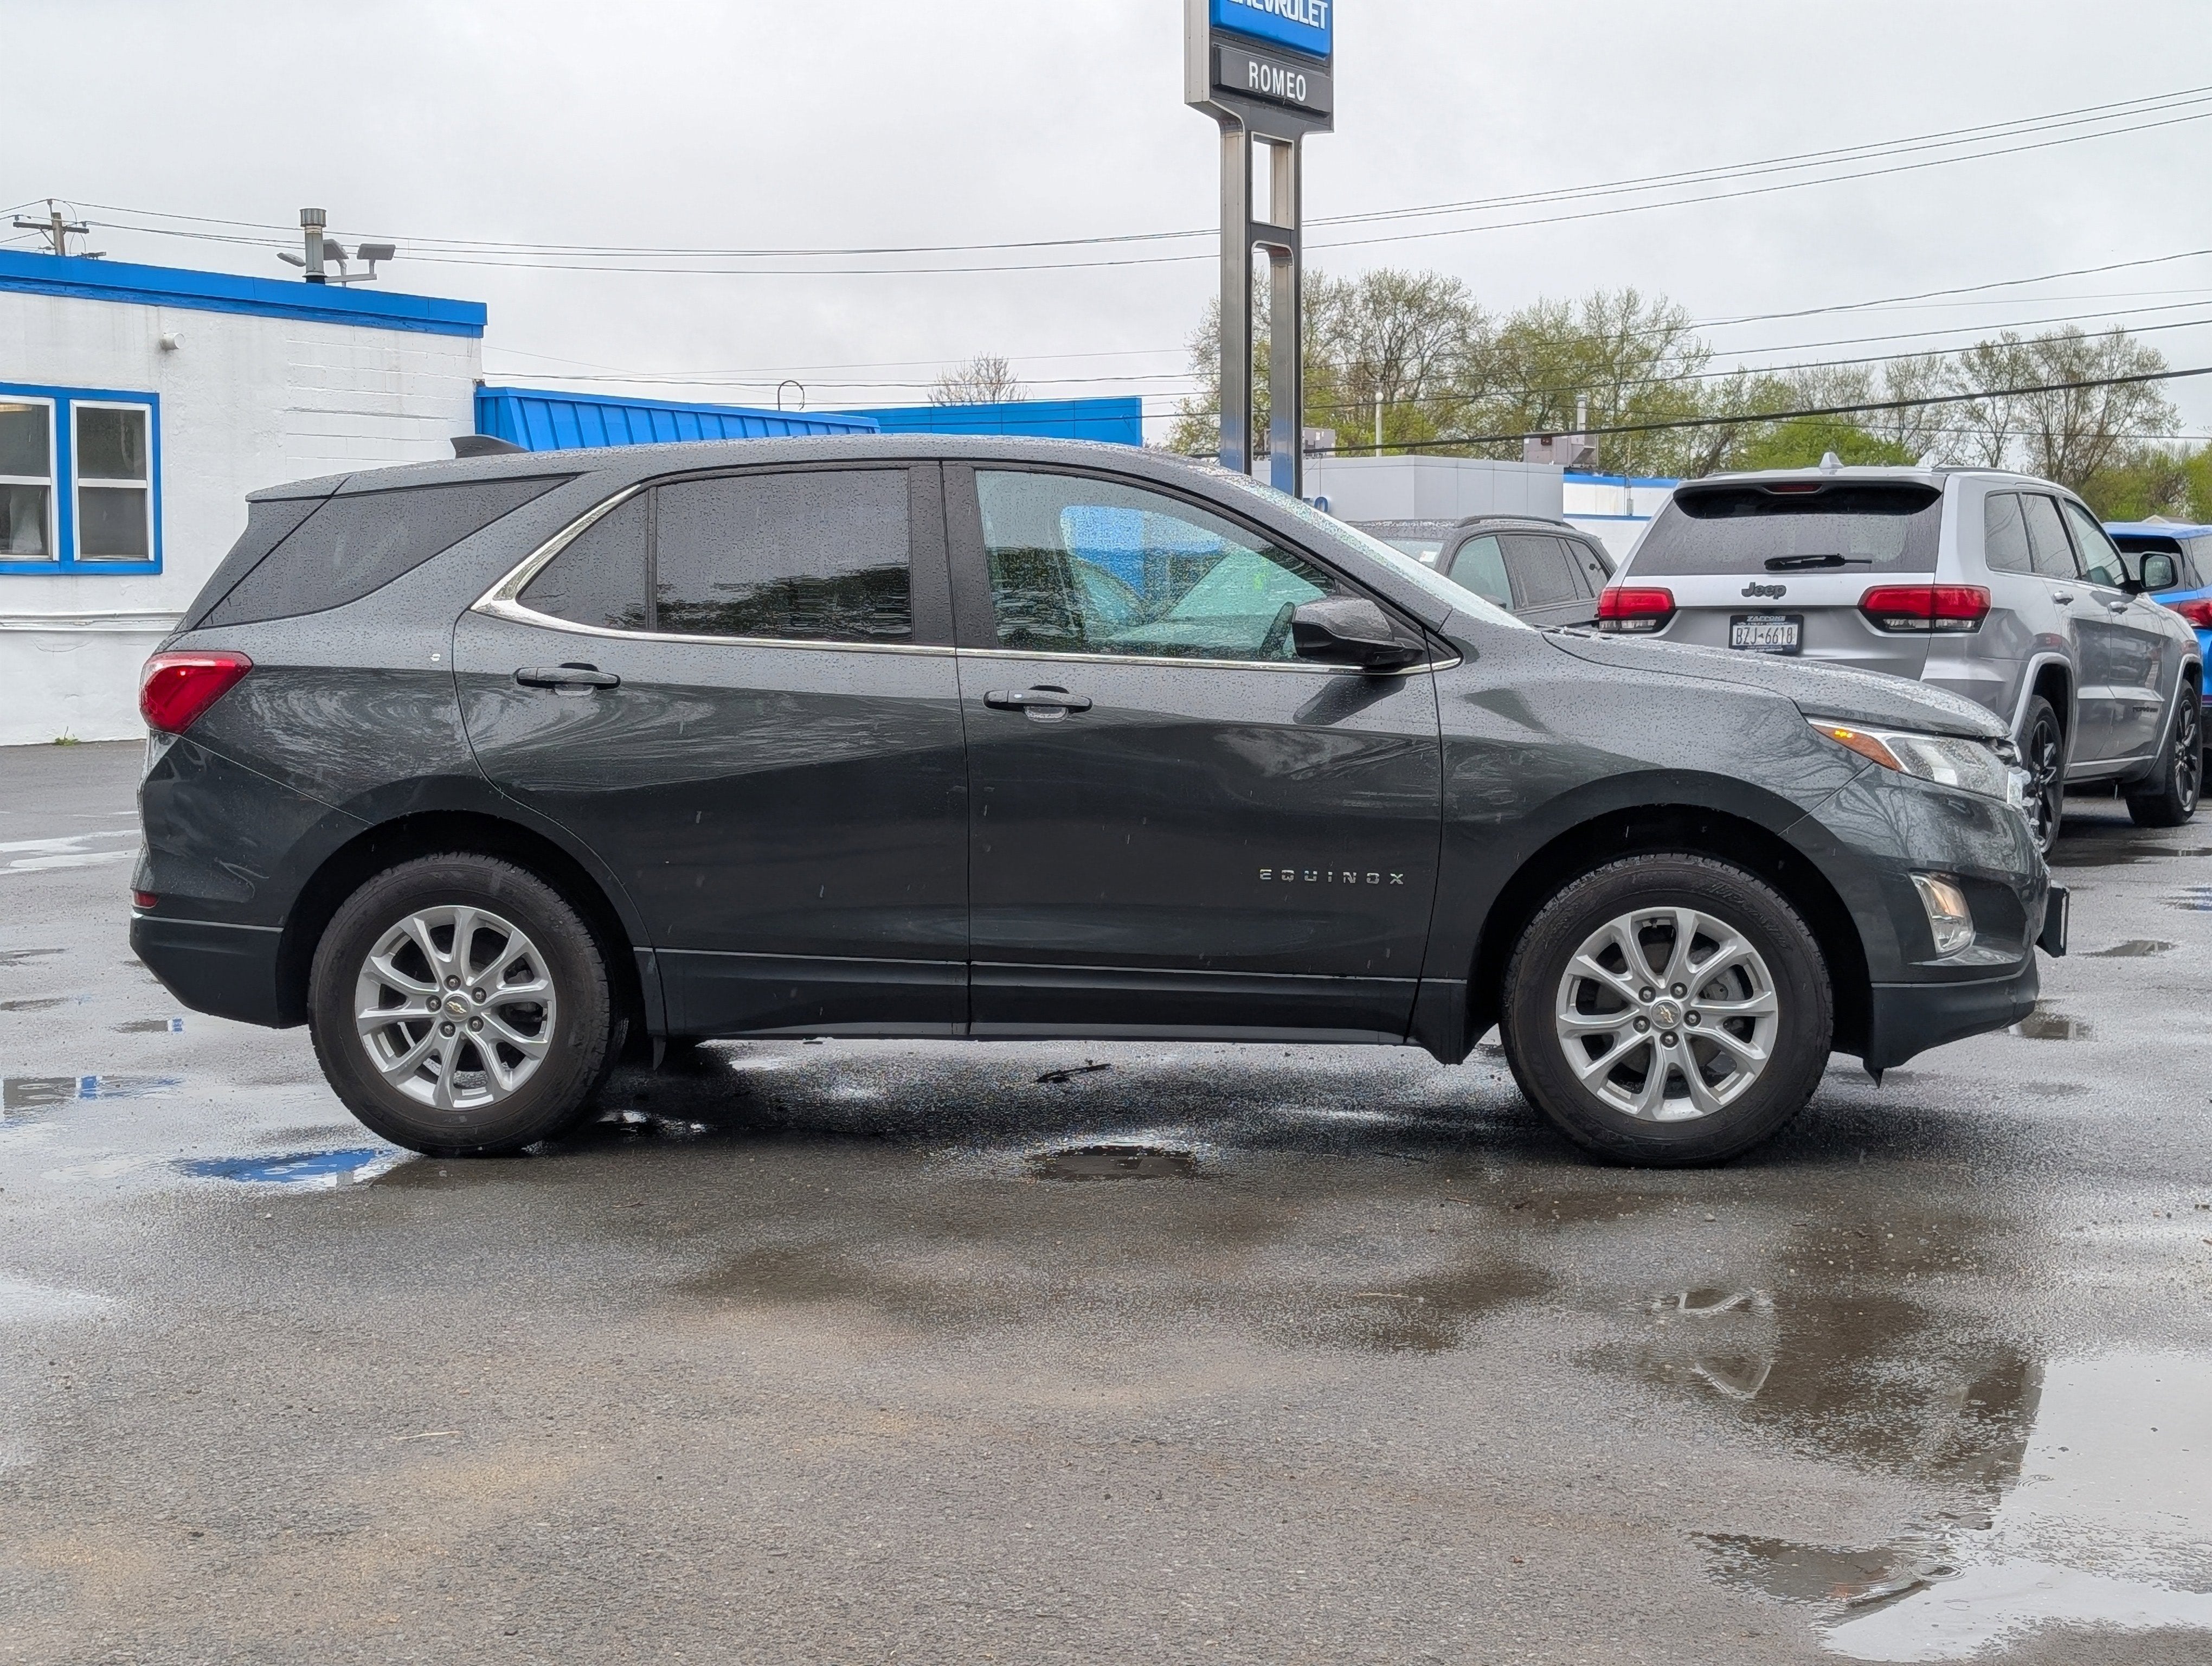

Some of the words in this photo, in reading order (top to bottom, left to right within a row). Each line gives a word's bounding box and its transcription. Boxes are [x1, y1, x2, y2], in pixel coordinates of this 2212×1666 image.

[1226, 0, 1328, 29] ROLET
[1249, 61, 1306, 101] ROMEO
[1741, 582, 1786, 600] Jeep
[1259, 869, 1404, 885] EQUINOX
